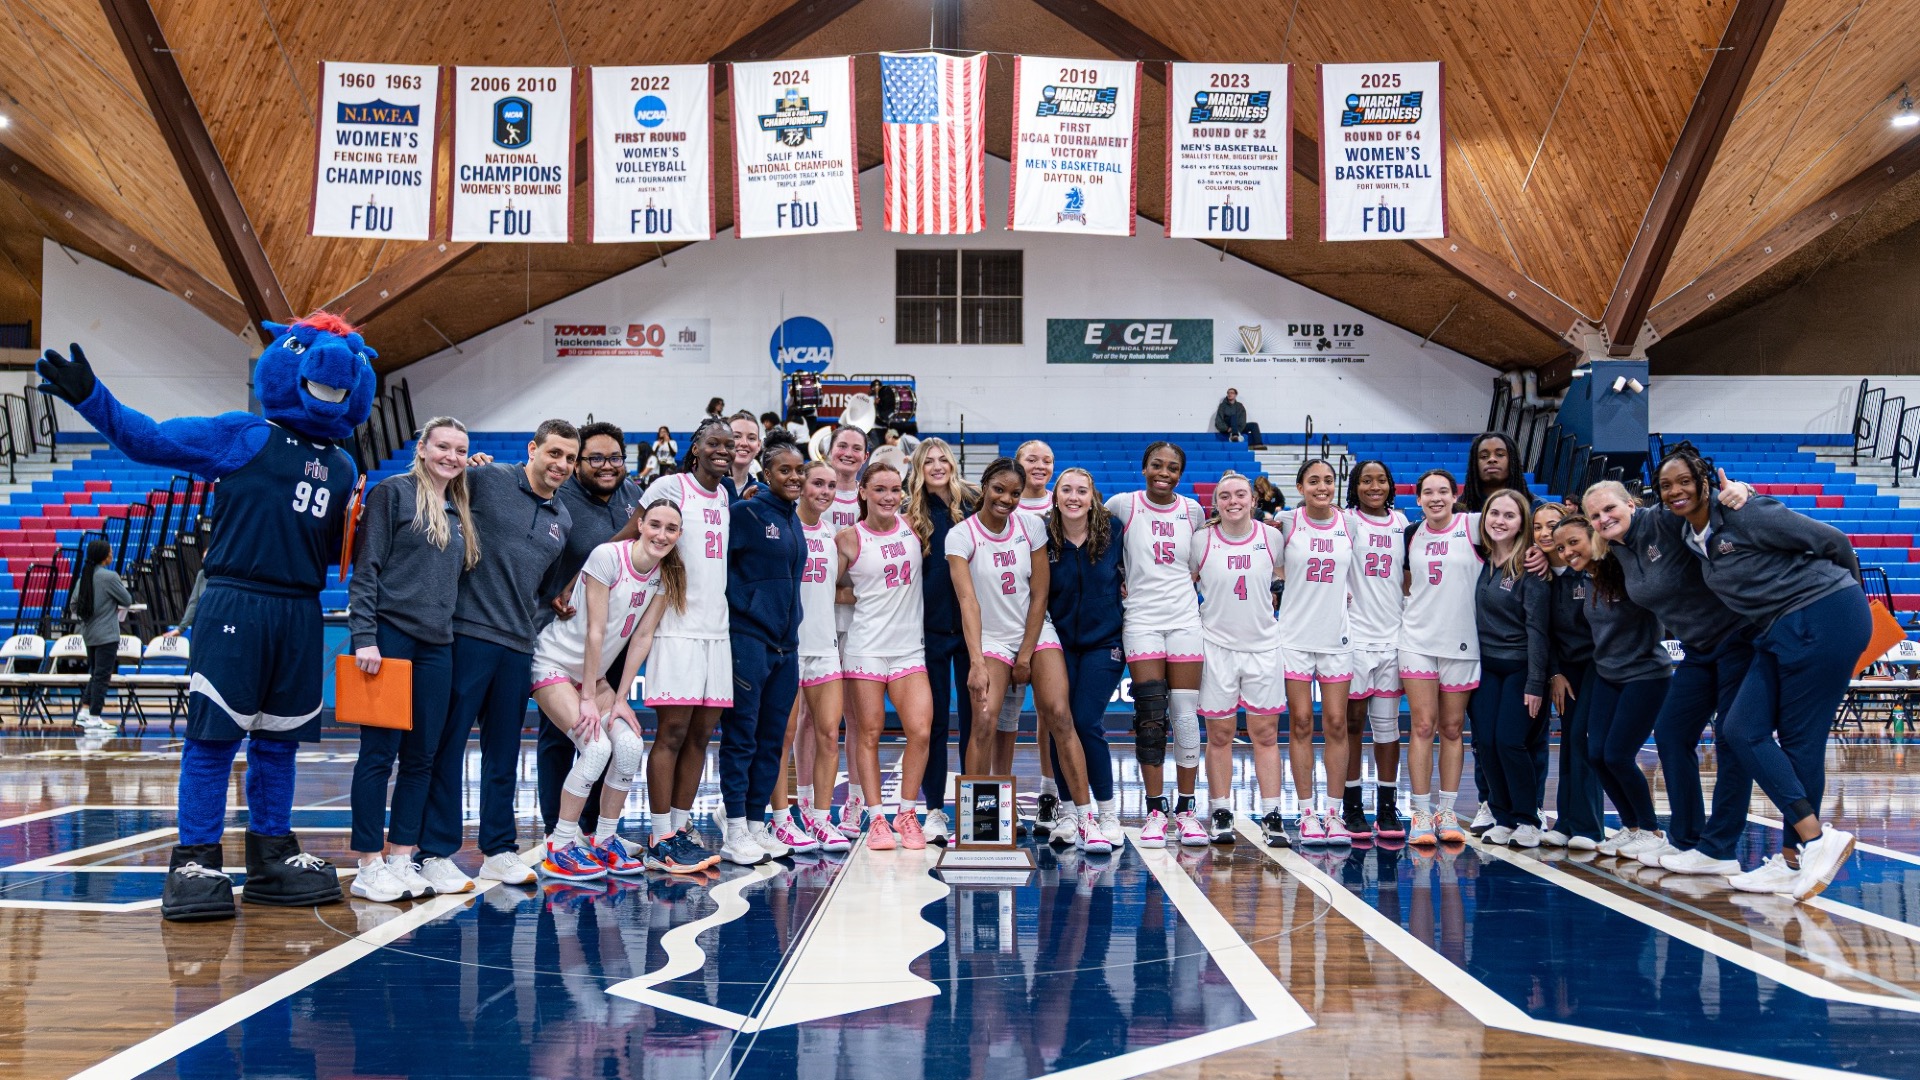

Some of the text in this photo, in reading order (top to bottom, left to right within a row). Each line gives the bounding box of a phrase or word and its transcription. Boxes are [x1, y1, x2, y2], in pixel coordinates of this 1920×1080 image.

[339, 73, 422, 90] 1960 1963
[631, 76, 670, 91] 2022
[773, 70, 810, 85] 2024
[1060, 68, 1097, 84] 2019
[1210, 74, 1250, 88] 2023
[1361, 74, 1401, 88] 2025
[471, 77, 557, 92] 2006 2010
[1055, 88, 1096, 102] MARCH
[1208, 93, 1249, 106] MARCH
[1358, 95, 1401, 108] MARCH
[637, 110, 666, 120] NCAA
[1059, 101, 1115, 114] MADNESS
[1212, 106, 1267, 118] MADNESS
[1364, 108, 1420, 120] MADNESS
[764, 115, 823, 127] CHAMPIONSHIPS
[1060, 122, 1091, 133] FIRST
[336, 130, 418, 148] WOMEN'S
[615, 132, 686, 143] FIRST ROUND
[1022, 133, 1129, 148] NCAA TOURNAMENT
[1193, 128, 1266, 138] ROUND OF 32
[1345, 131, 1420, 142] ROUND OF 64
[334, 151, 417, 164] FENCING TEAM
[486, 154, 538, 164] NATIONAL
[624, 147, 679, 158] WOMEN'S
[767, 150, 823, 162] SALIF MANE
[1051, 148, 1098, 158] VICTORY
[1345, 146, 1420, 161] WOMEN'S
[460, 165, 562, 182] CHAMPIONS
[616, 161, 686, 173] VOLLEYBALL
[748, 160, 843, 174] NATIONAL CHAMPION
[1026, 159, 1122, 173] MEN'S BASKETBALL
[1335, 164, 1432, 180] BASKETBALL
[326, 167, 422, 186] CHAMPIONS
[1044, 173, 1103, 185] DAYTON, OH
[461, 184, 561, 195] WOMEN'S BOWLING
[351, 205, 393, 232] FDU
[490, 210, 531, 235] FDU
[631, 209, 672, 234] FDU
[777, 202, 818, 228] FDU
[1208, 206, 1250, 232] FDU
[1363, 207, 1405, 232] FDU
[554, 325, 606, 336] TOYOTA
[626, 324, 665, 347] 50
[679, 331, 696, 342] FDU
[1084, 323, 1178, 345] EXCEL
[1288, 324, 1363, 336] PUB 178
[555, 338, 621, 346] Hackensack
[777, 347, 832, 363] NCAA
[305, 461, 328, 481] FDU
[293, 481, 330, 518] 99
[703, 509, 721, 525] FDU
[833, 512, 854, 525] FDU
[1151, 521, 1174, 537] FDU
[705, 531, 722, 559] 21
[1310, 538, 1333, 553] FDU
[1369, 533, 1392, 548] FDU
[880, 541, 906, 559] FDU
[1153, 542, 1175, 565] 15
[1425, 541, 1449, 556] FDU
[993, 550, 1016, 567] FDU
[1228, 555, 1251, 570] FDU
[1365, 553, 1392, 578] 23
[802, 558, 828, 583] 25
[884, 561, 911, 589] 24
[1306, 558, 1335, 583] 22
[1428, 561, 1442, 585] 5
[1001, 572, 1016, 595] 2
[1234, 575, 1247, 600] 4
[620, 614, 636, 638] 0
